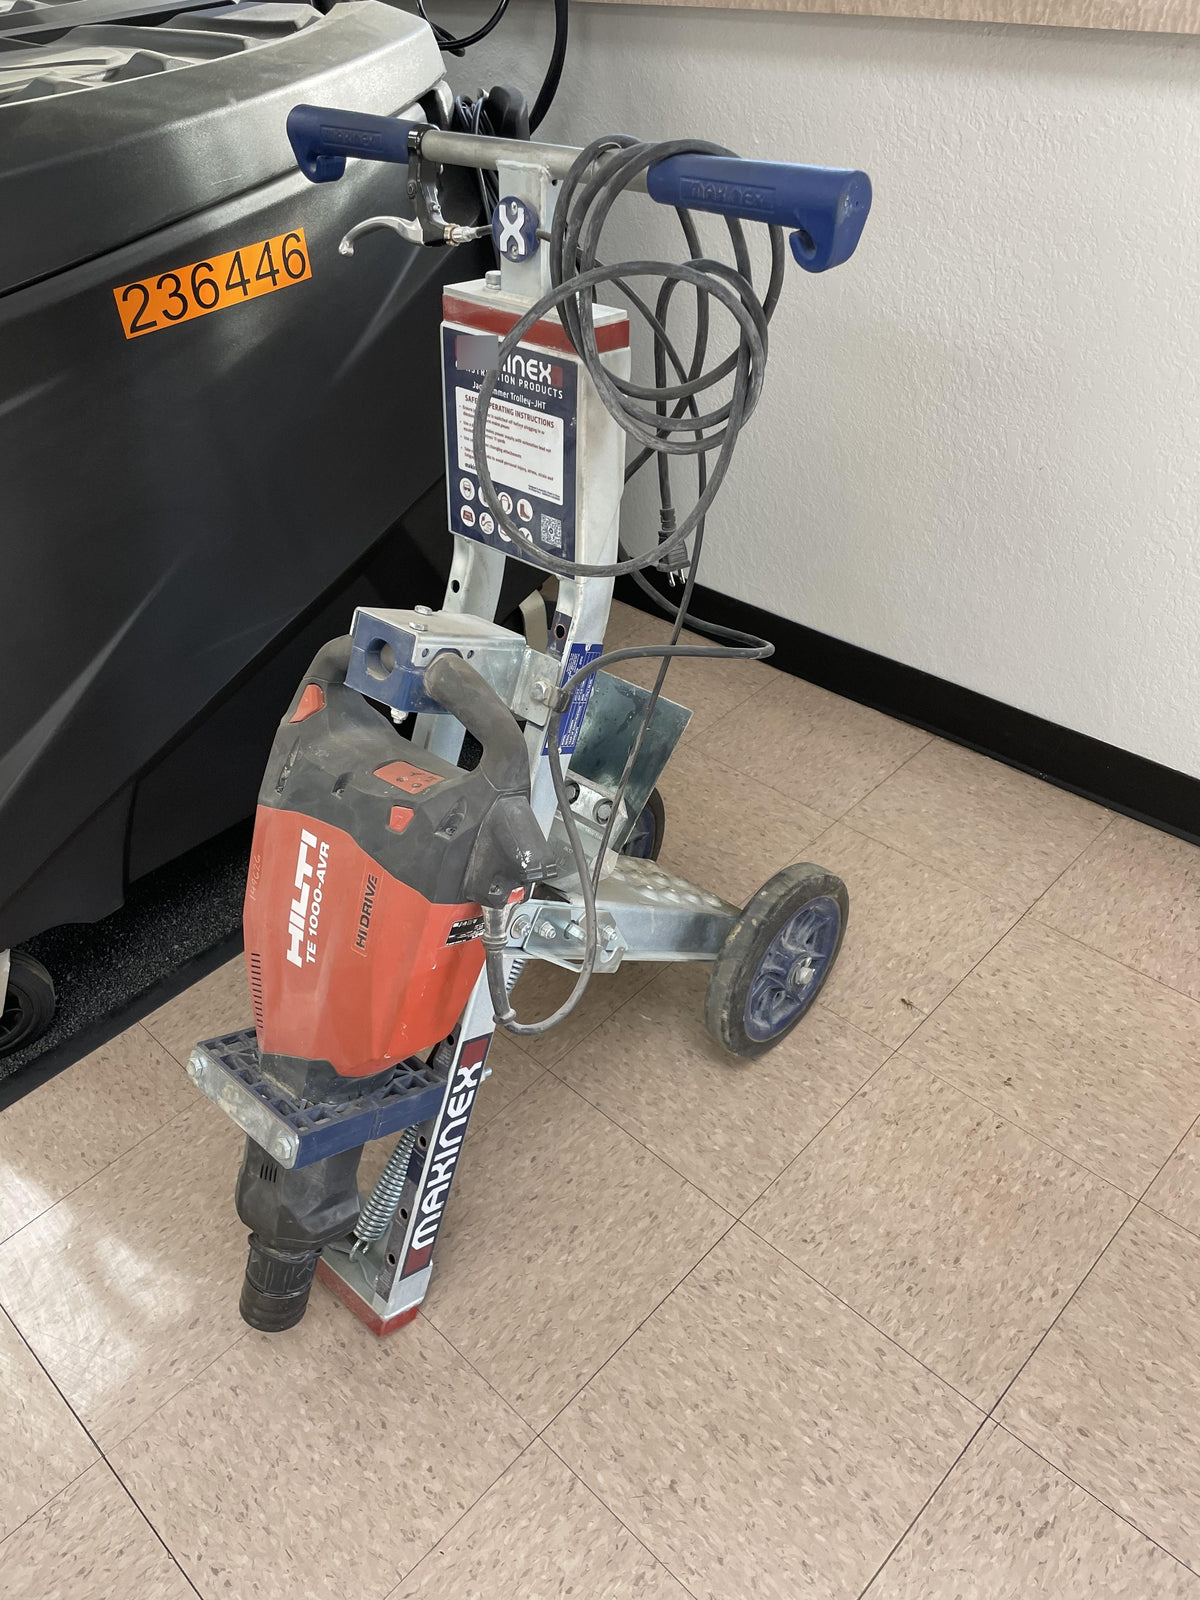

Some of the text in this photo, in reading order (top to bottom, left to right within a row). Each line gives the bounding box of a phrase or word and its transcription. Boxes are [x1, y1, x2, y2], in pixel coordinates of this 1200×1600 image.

[122, 232, 306, 335] 236446
[488, 403, 514, 416] PERATING
[515, 408, 554, 428] INSTRUCTIONS
[510, 392, 547, 410] Trolley-JHT
[519, 378, 563, 400] PRODUCTS
[286, 828, 318, 968] HILTI
[306, 841, 330, 963] TE 1000-AVR
[411, 1060, 483, 1251] MAKINEX
